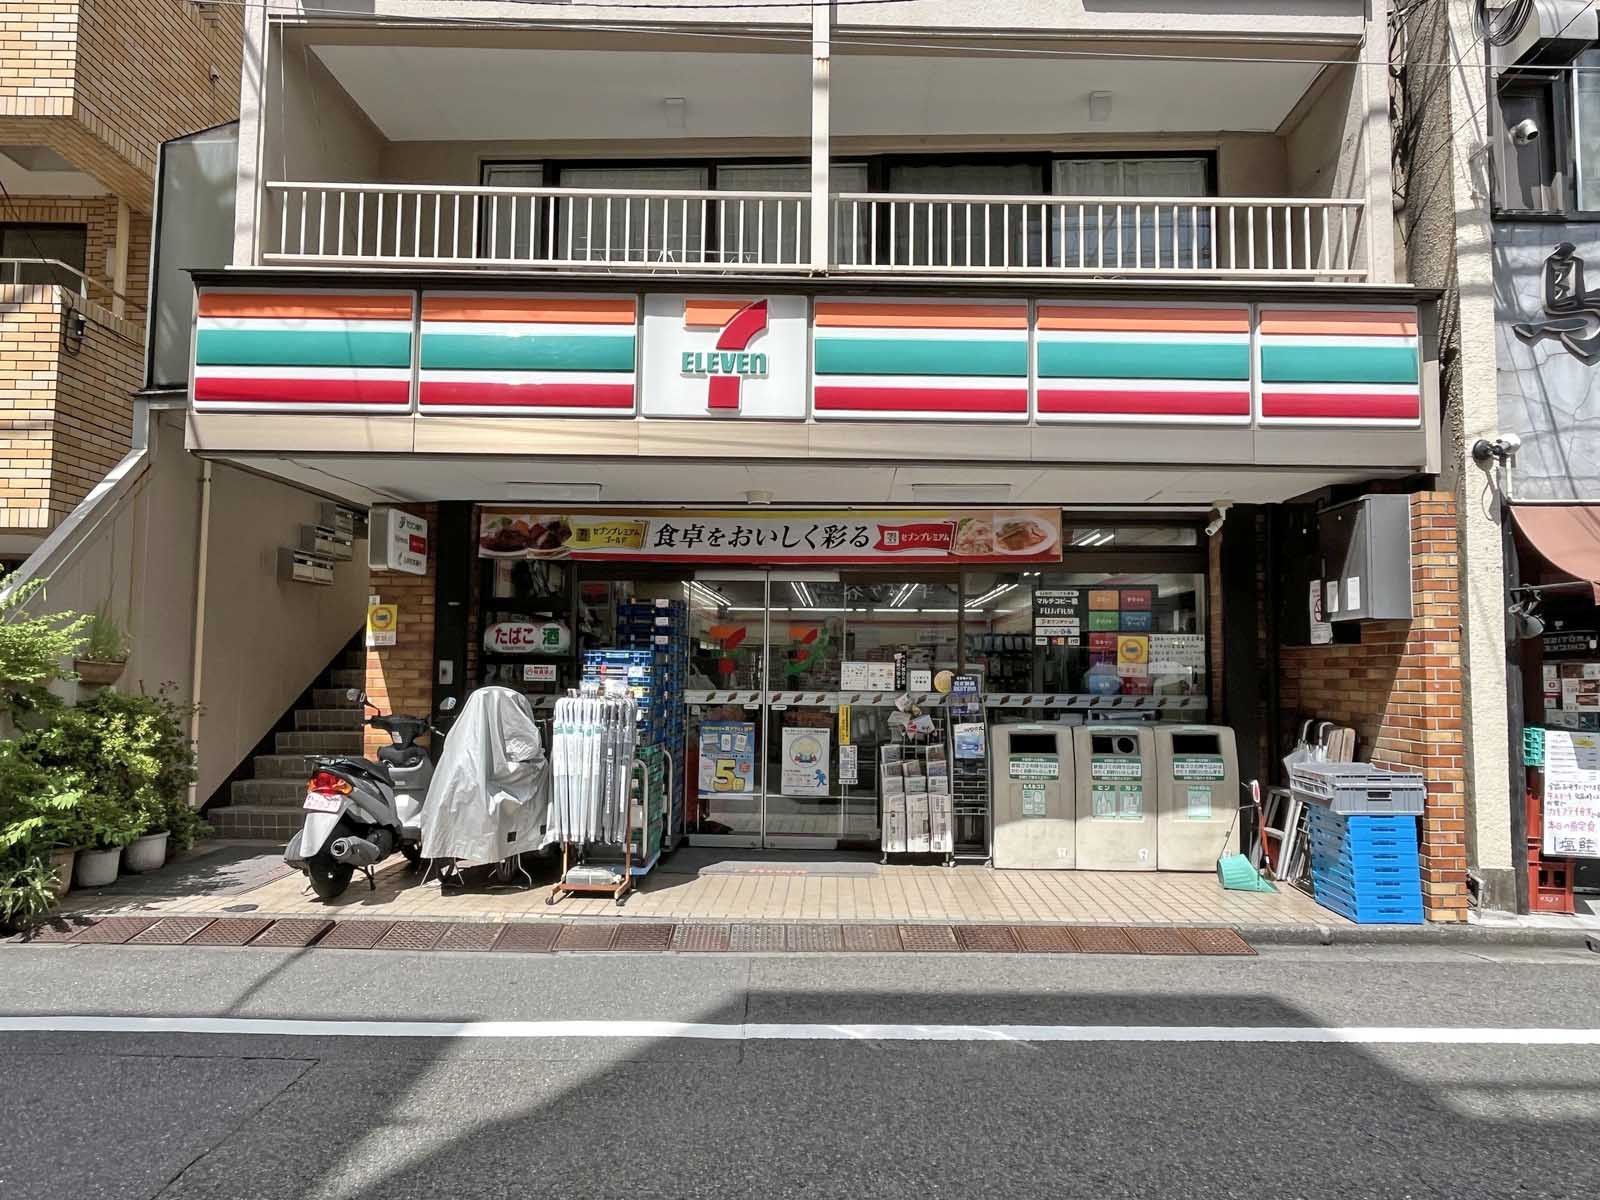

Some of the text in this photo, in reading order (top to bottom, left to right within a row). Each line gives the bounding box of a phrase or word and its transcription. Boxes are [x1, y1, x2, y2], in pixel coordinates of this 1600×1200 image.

[593, 527, 640, 536] セブンプレミアム
[653, 523, 869, 550] 食卓をおいしく彩る
[901, 532, 949, 542] セブンプレミアム
[1040, 607, 1074, 615] FUJIFILM
[495, 627, 561, 645] たばこ 酒
